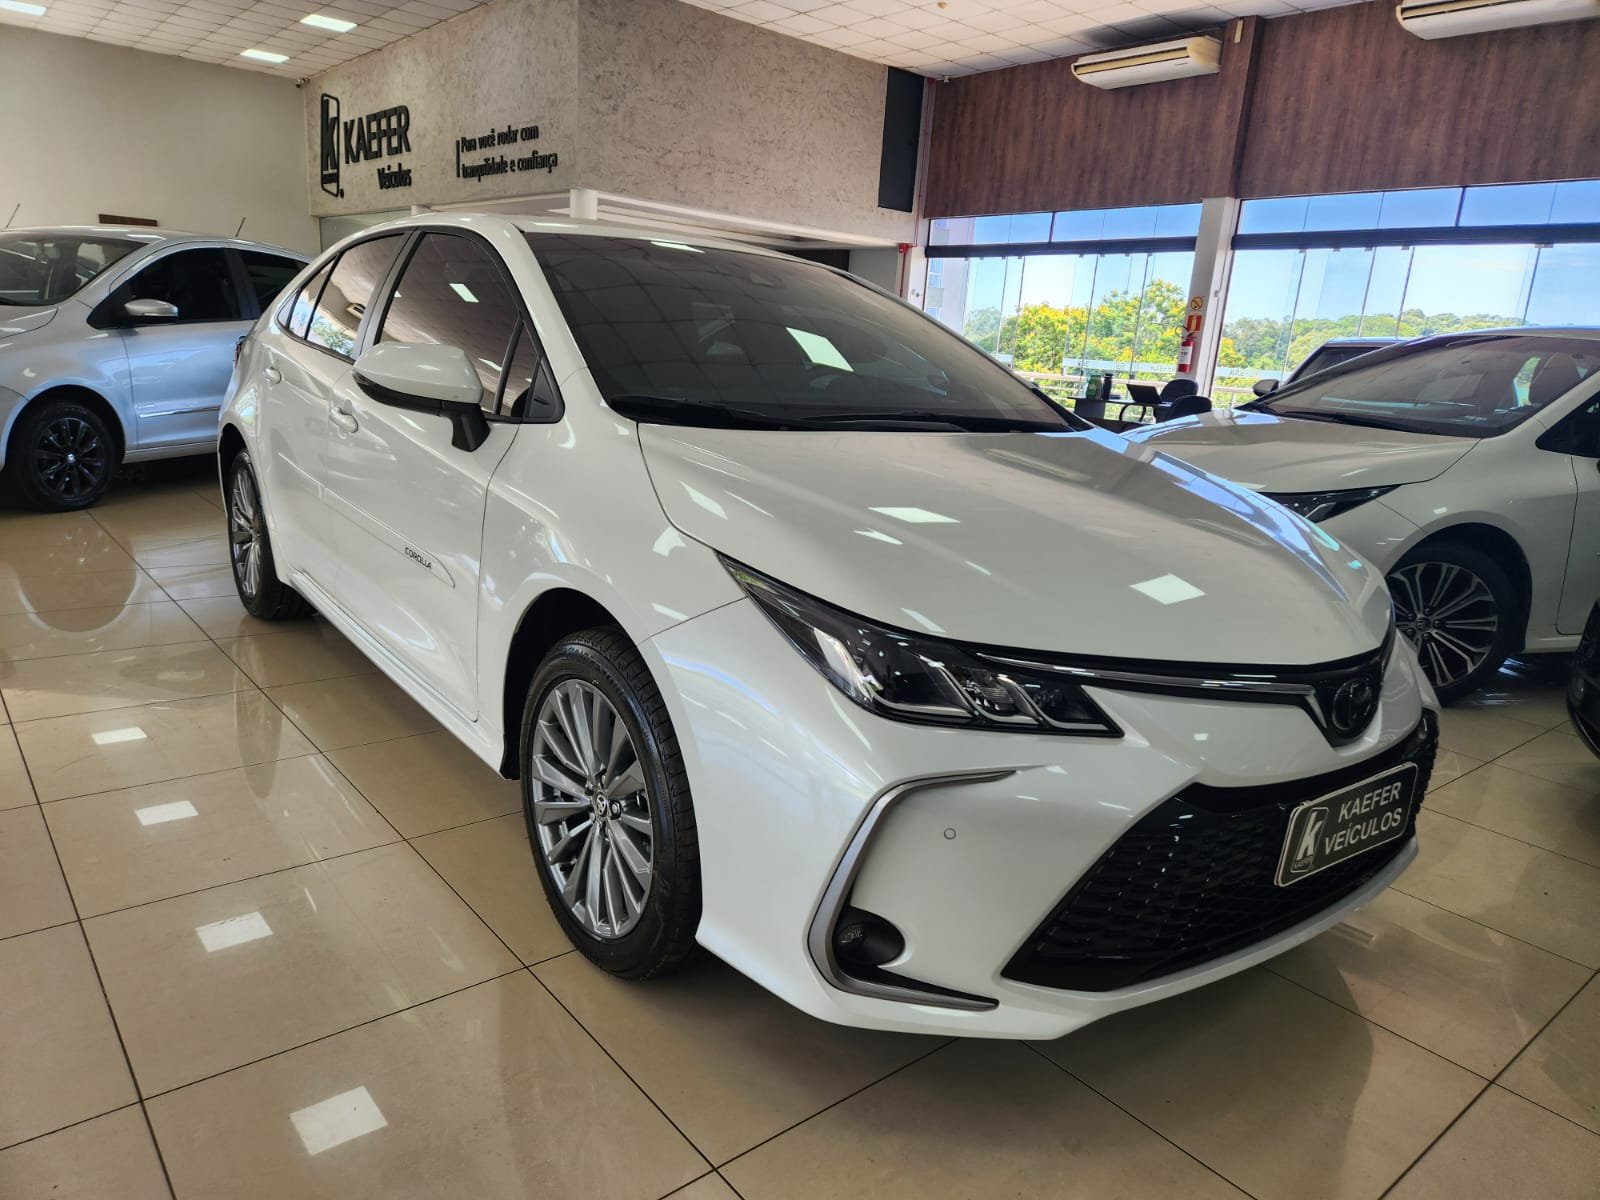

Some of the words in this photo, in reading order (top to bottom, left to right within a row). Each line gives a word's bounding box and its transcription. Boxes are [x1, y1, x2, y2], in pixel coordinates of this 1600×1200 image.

[343, 105, 411, 164] KAEFER
[461, 137, 477, 152] Para
[478, 128, 496, 149] você
[497, 125, 519, 146] rodar
[520, 125, 539, 141] com
[462, 155, 508, 182] tranquilidade
[510, 159, 516, 173] e
[517, 150, 558, 174] confiança
[405, 546, 432, 571] COROLLA
[1338, 782, 1402, 823] KAEFER
[1325, 807, 1402, 855] VEÍCULOS
